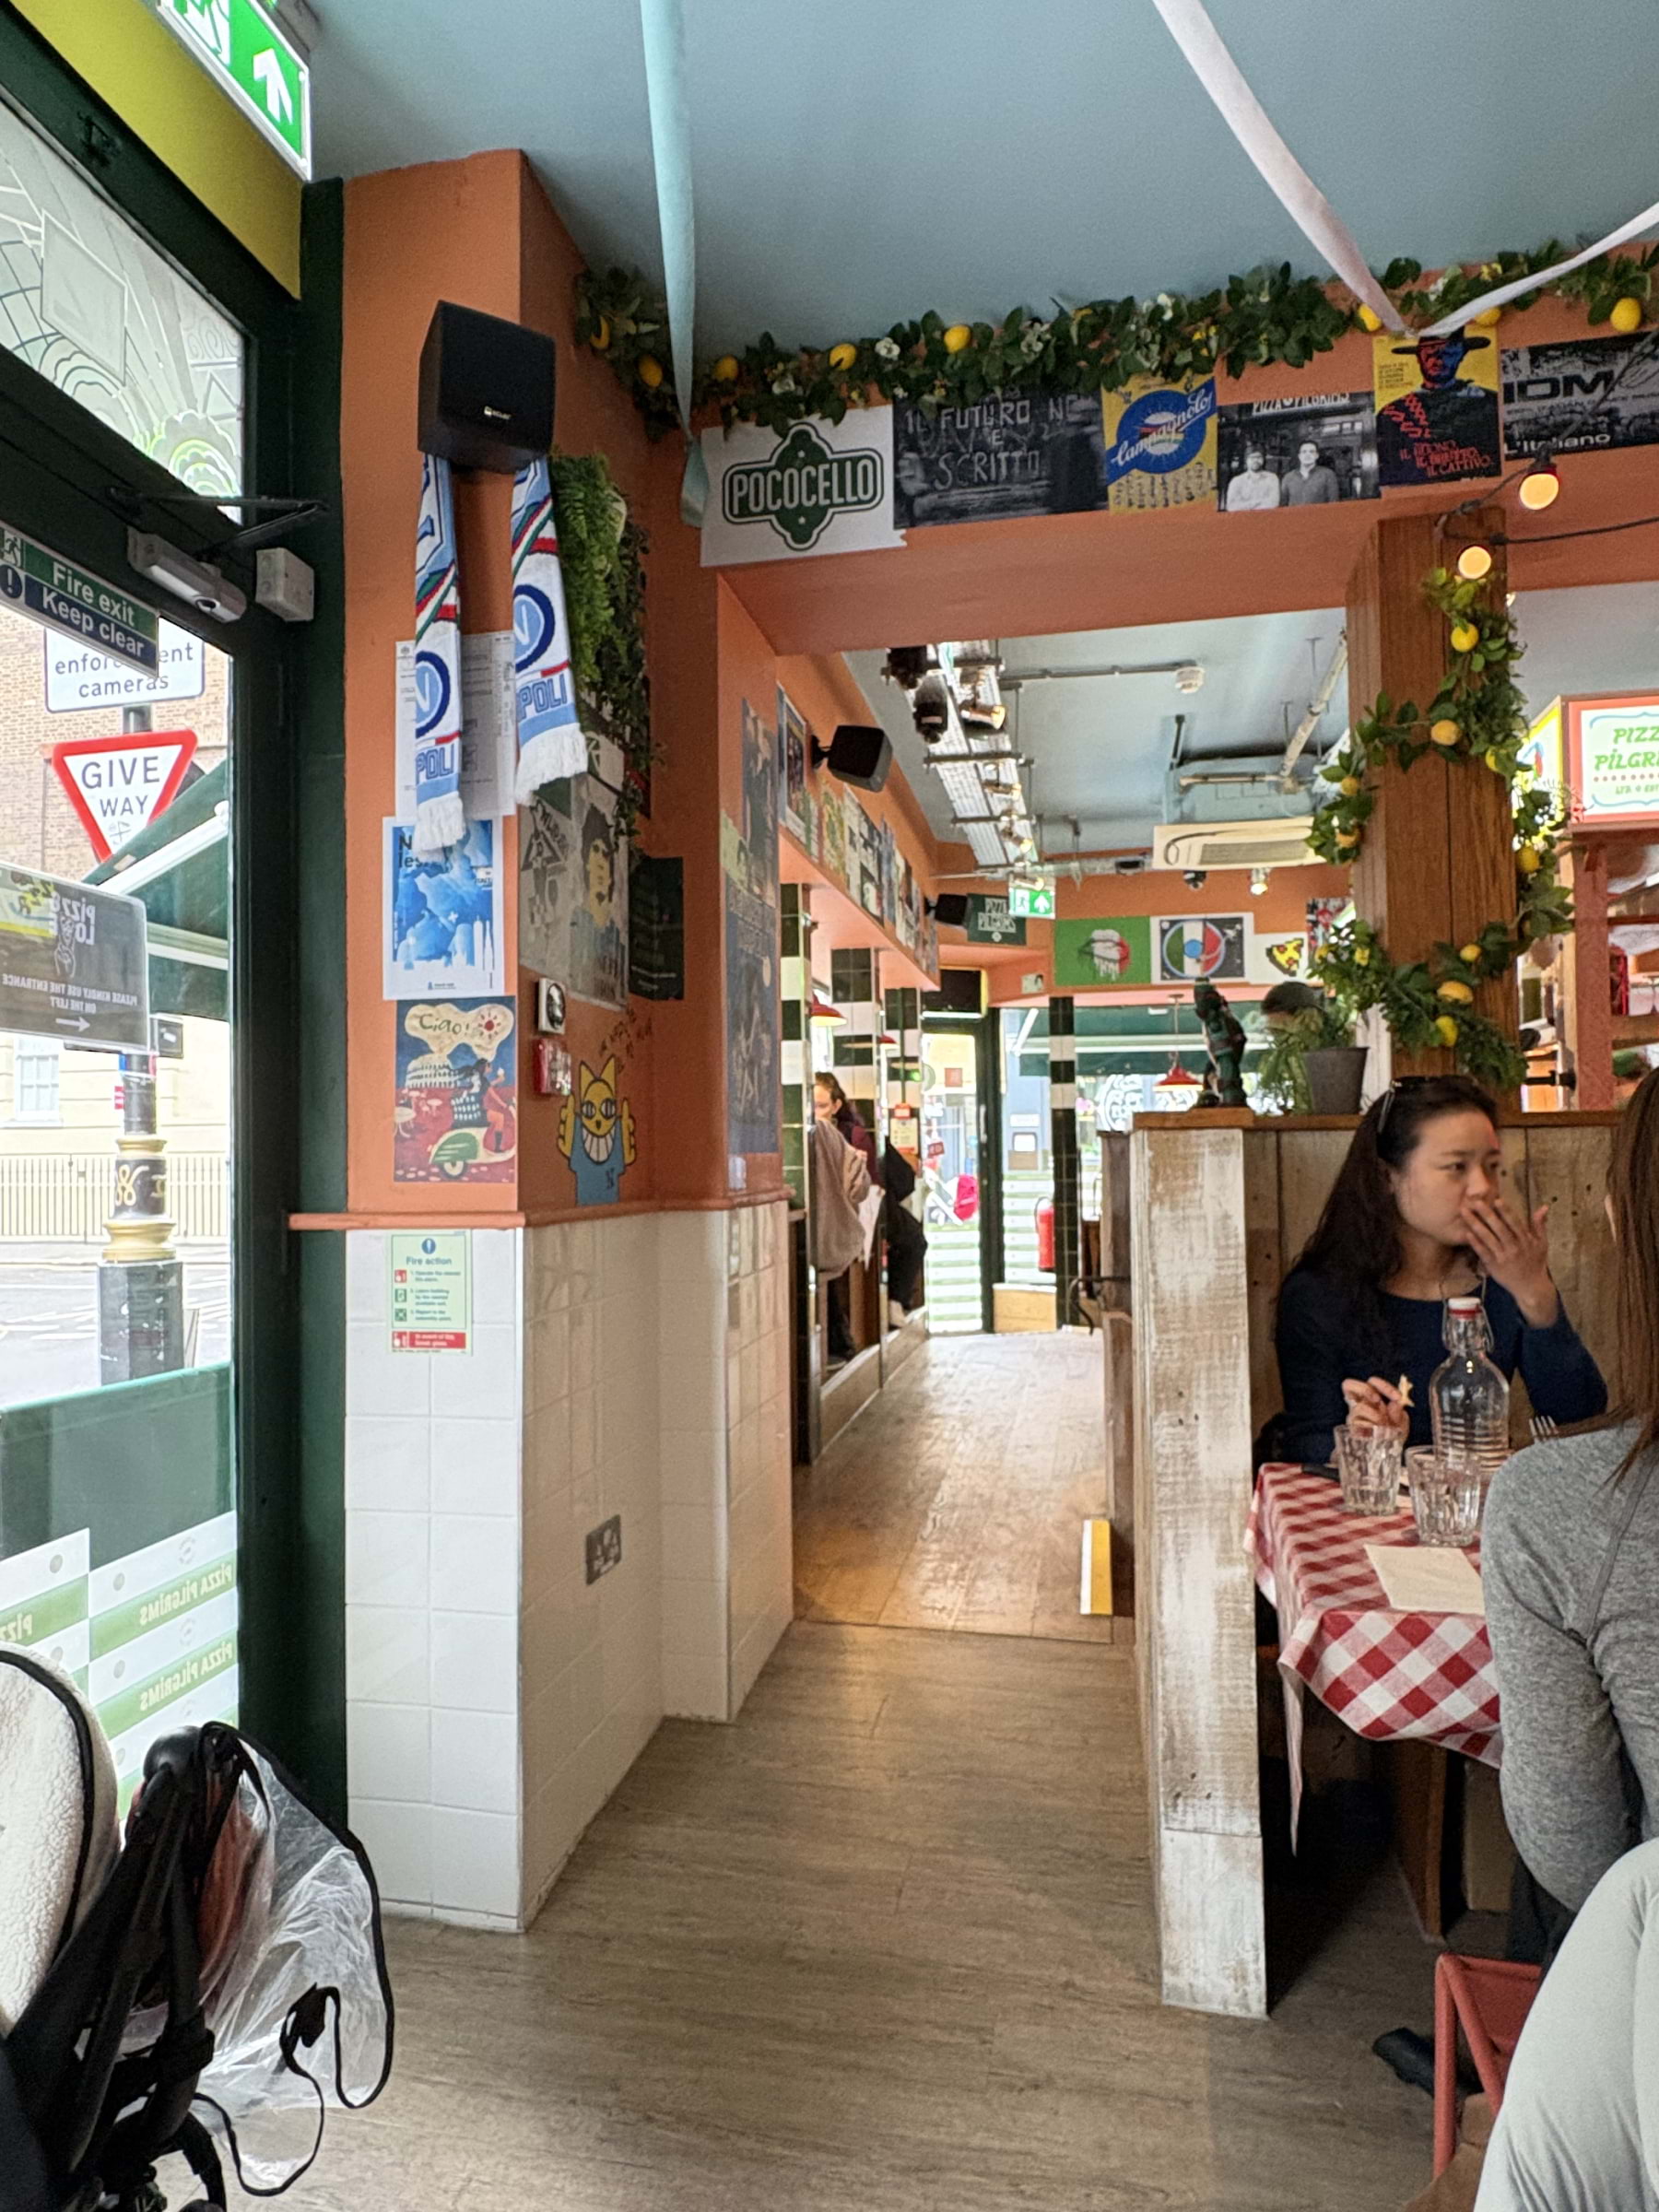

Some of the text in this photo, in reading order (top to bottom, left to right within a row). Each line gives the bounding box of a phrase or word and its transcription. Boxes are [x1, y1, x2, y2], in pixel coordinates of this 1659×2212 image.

[941, 399, 1030, 429] FUTURO
[1503, 433, 1611, 453] L'Itliano
[934, 450, 1040, 490] SCRITTO
[734, 458, 875, 515] POCOCELLO
[53, 561, 135, 628] Fire exit
[42, 585, 145, 657] Keep clear
[55, 641, 194, 675] enforent
[78, 676, 170, 698] cameras
[81, 756, 160, 789] GIVE
[99, 794, 149, 818] WAY
[418, 1013, 470, 1037] Ciao!
[406, 1256, 452, 1265] Fire action
